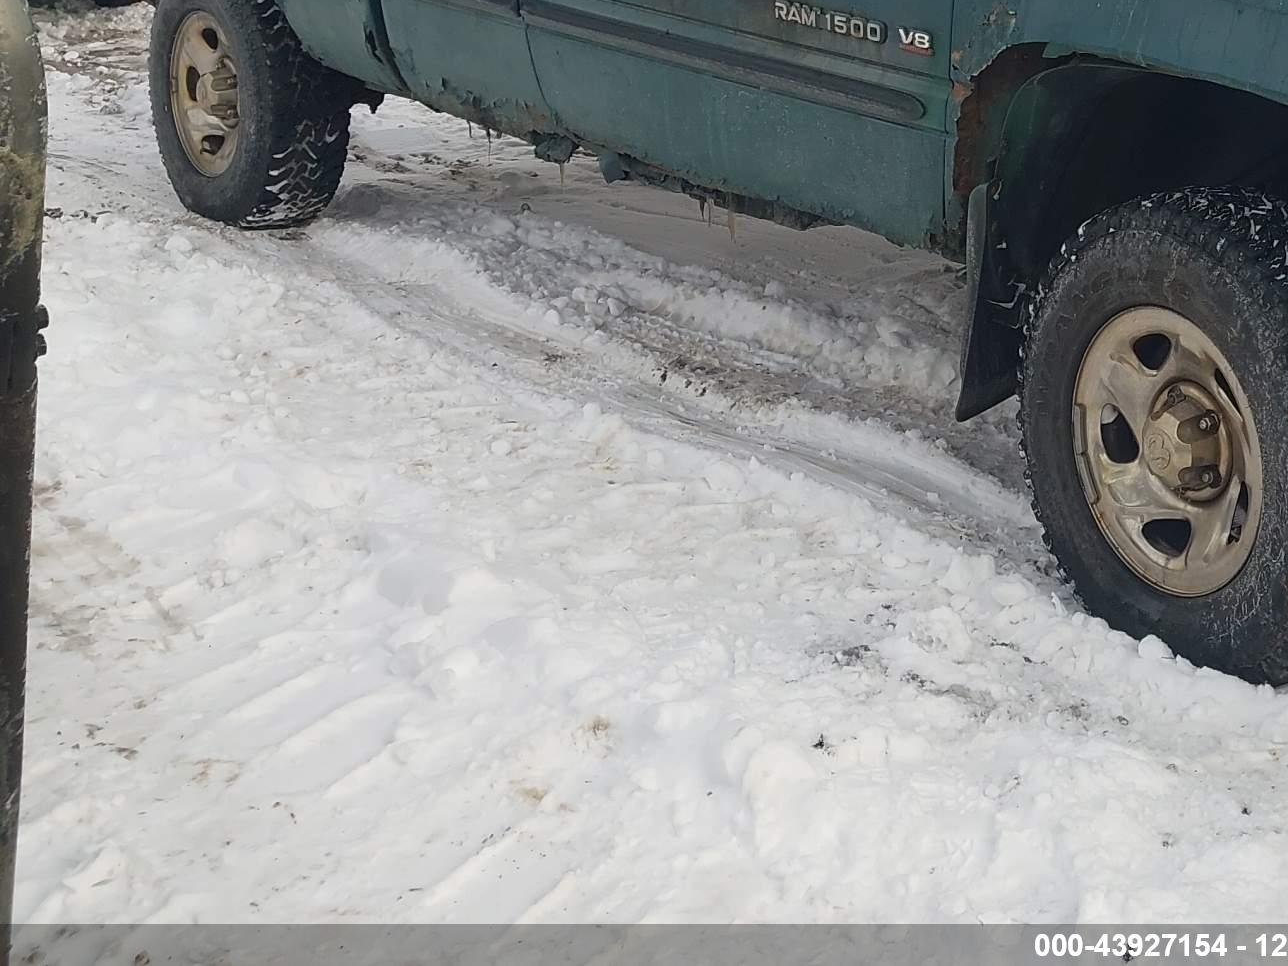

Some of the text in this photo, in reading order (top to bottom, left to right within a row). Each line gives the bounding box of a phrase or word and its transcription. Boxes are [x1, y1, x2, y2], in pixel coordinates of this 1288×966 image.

[775, 2, 930, 49] RAM 1500 V8
